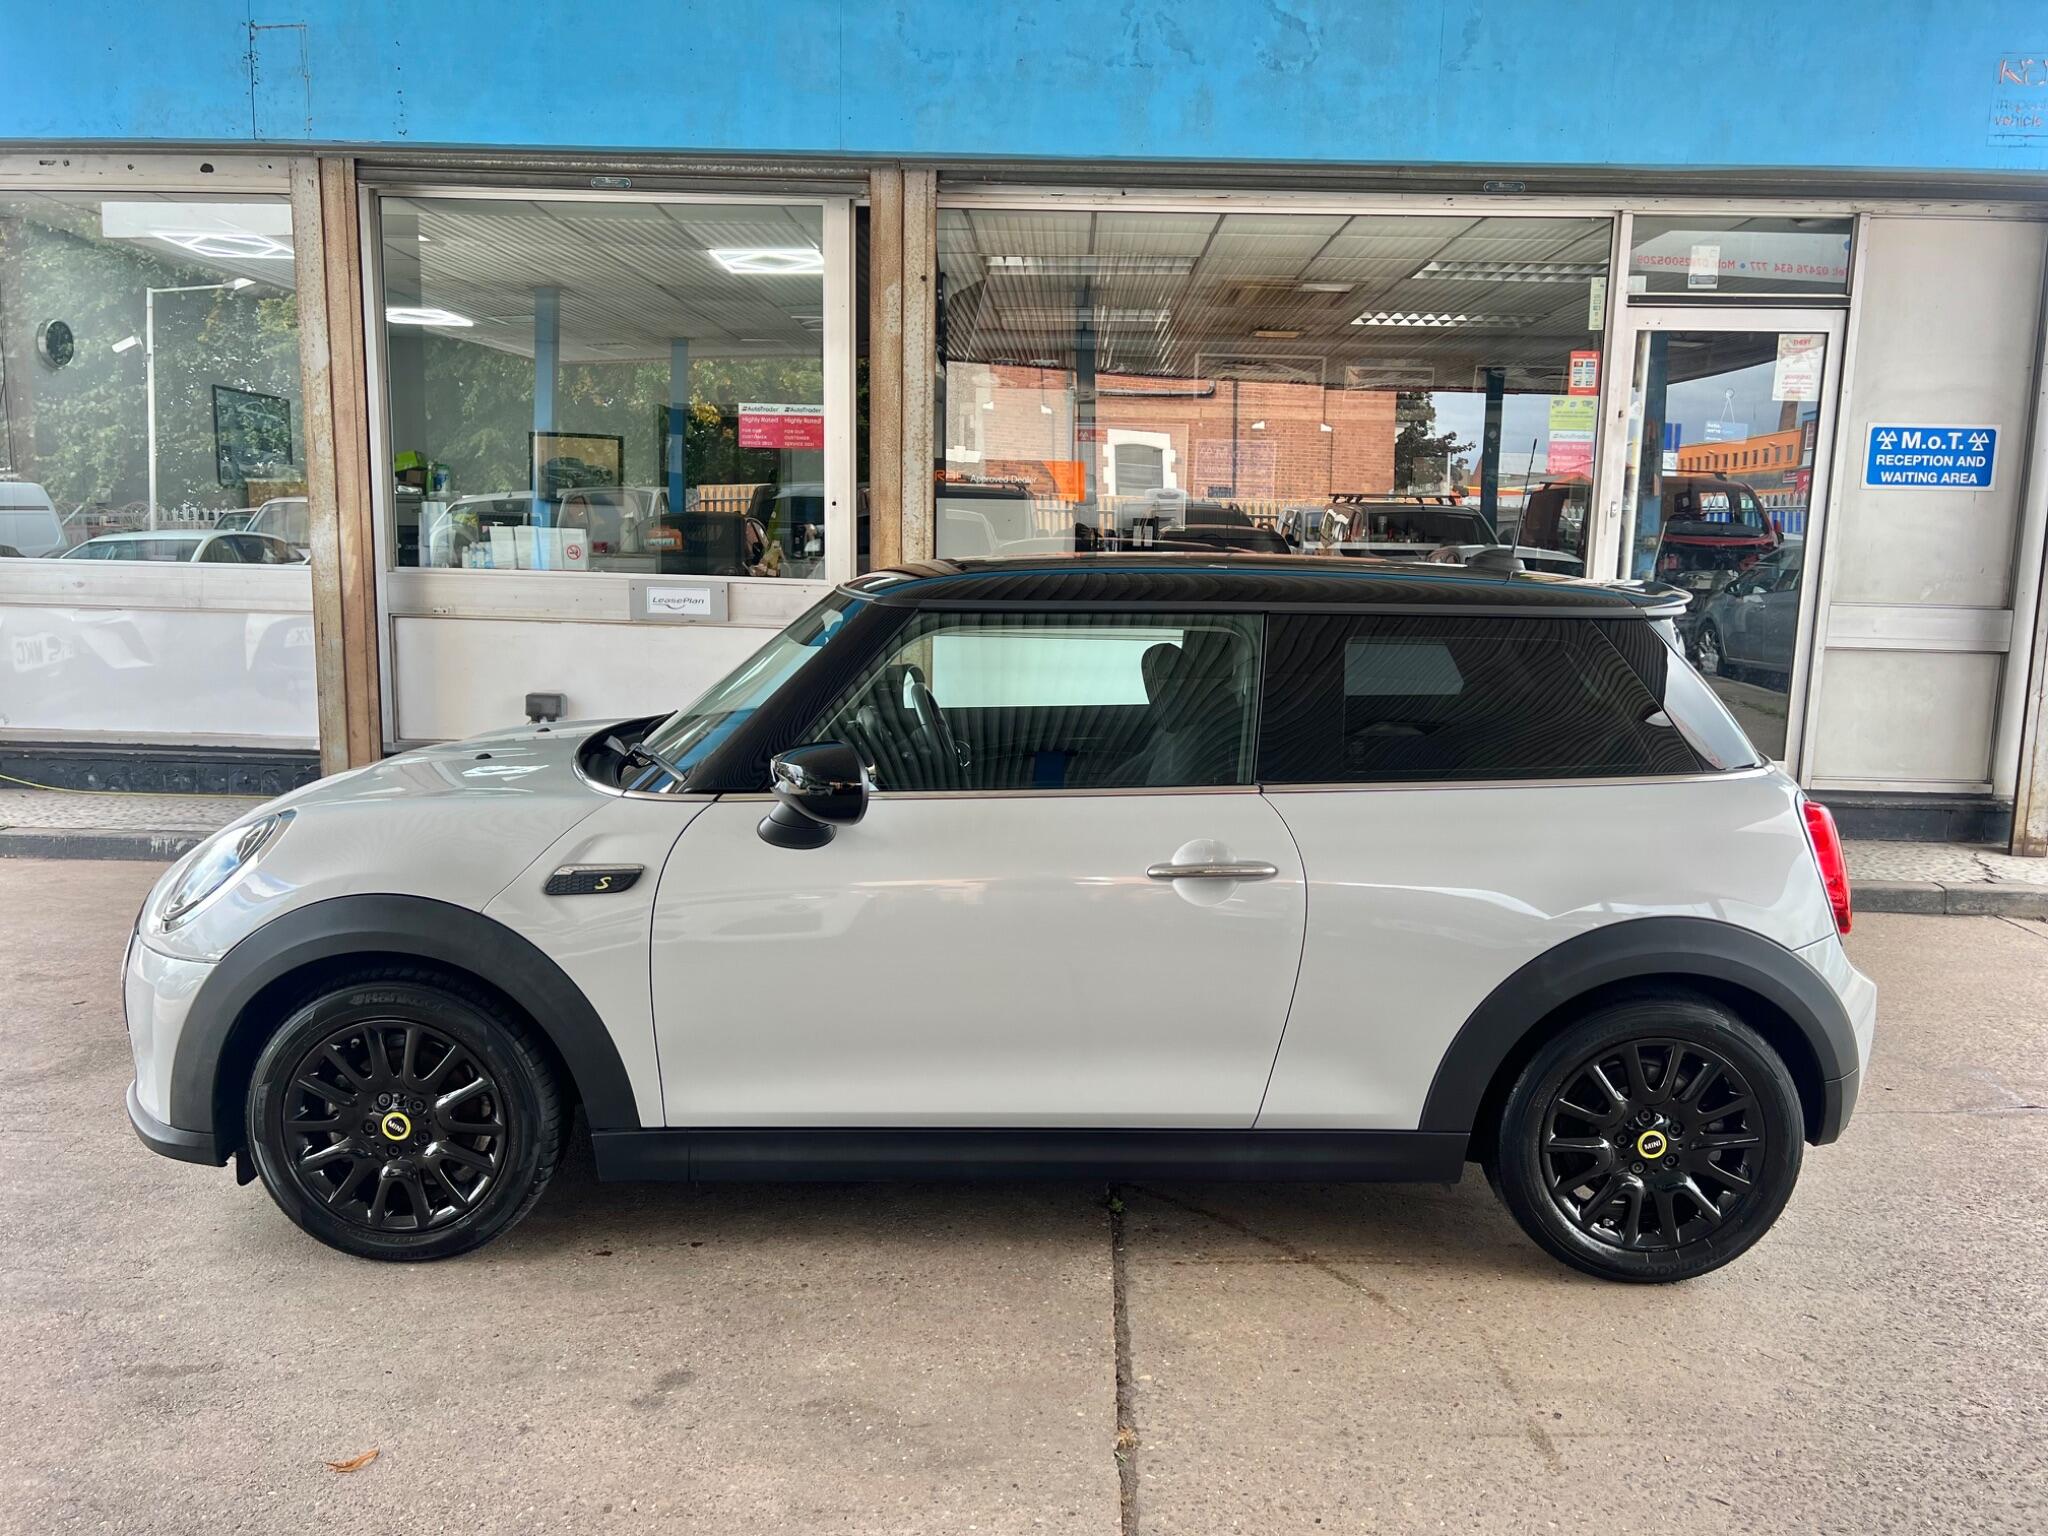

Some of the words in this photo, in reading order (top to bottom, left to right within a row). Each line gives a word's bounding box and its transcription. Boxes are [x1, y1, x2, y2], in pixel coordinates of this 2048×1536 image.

[742, 416, 760, 424] Highly
[1901, 431, 1964, 450] M.o.T.
[1875, 454, 1953, 467] RECEPTION
[1956, 455, 1986, 467] AND
[970, 473, 1009, 484] Approved
[1010, 475, 1037, 484] Dealer
[1880, 471, 1938, 483] WAITING
[1940, 473, 1978, 484] AREA
[652, 596, 705, 605] LeasePlan
[594, 876, 612, 890] S
[388, 1120, 404, 1133] MINI
[1644, 1140, 1661, 1150] MINI
